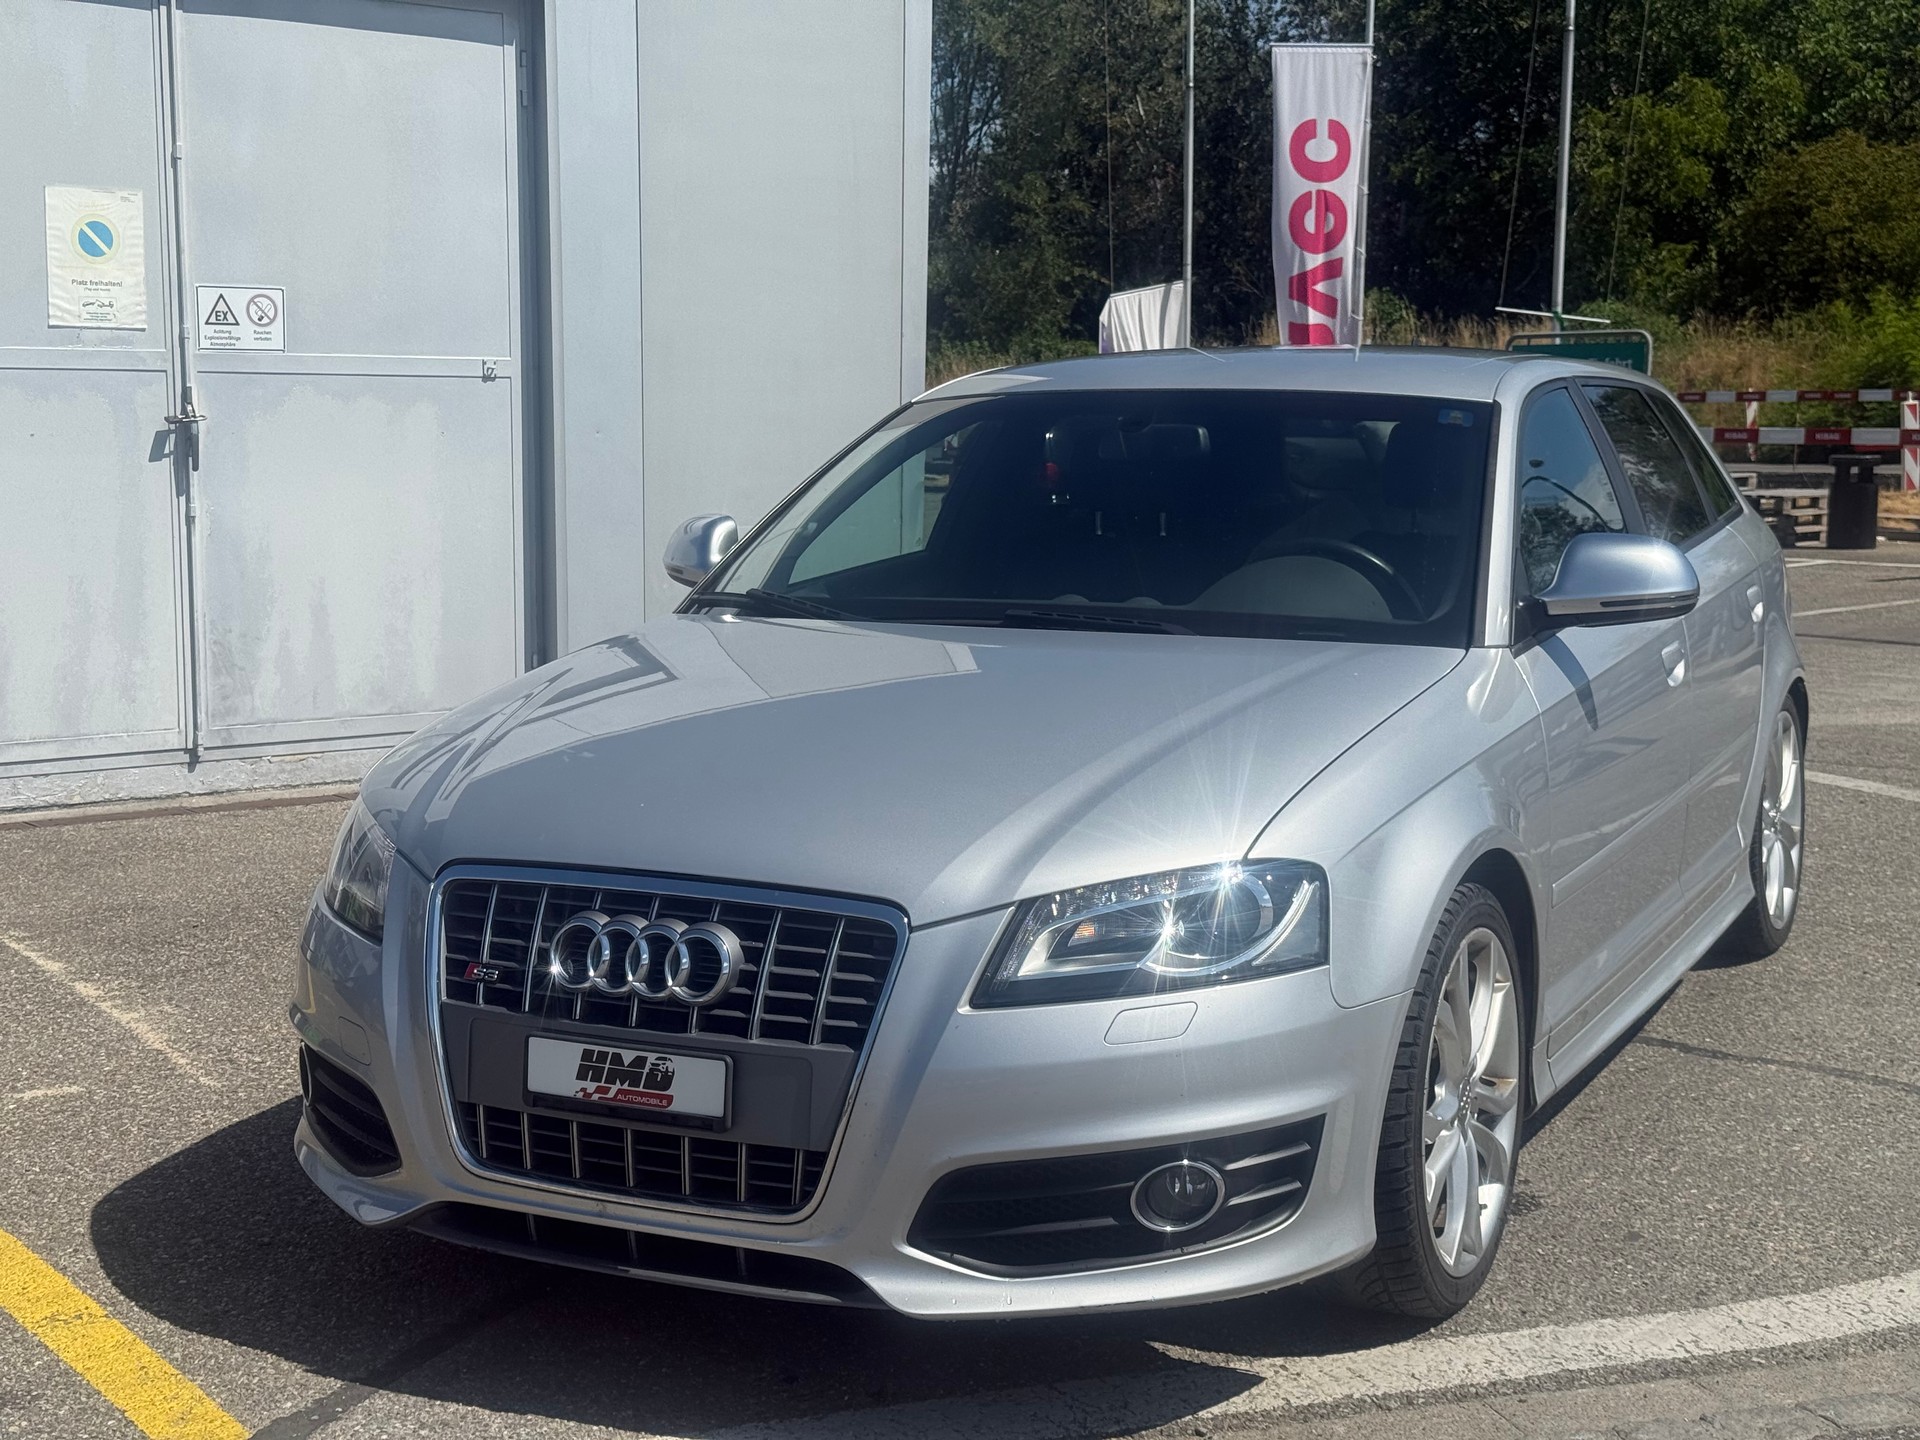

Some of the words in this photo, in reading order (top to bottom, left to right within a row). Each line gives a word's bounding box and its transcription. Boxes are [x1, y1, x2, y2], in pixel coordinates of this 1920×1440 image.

[215, 310, 229, 322] EX
[471, 966, 500, 981] S3
[616, 1093, 668, 1107] AUTOMOBILE
